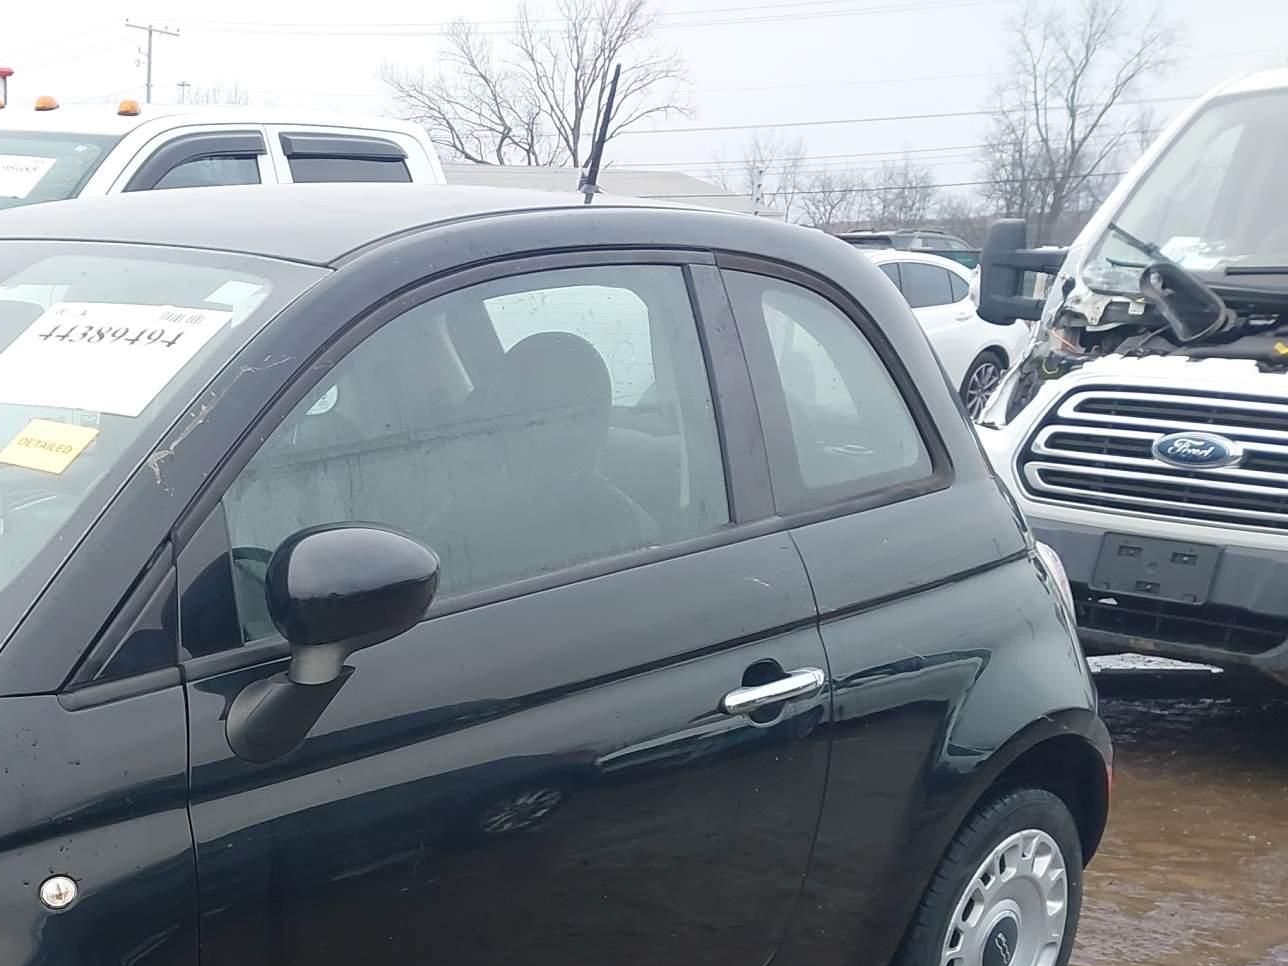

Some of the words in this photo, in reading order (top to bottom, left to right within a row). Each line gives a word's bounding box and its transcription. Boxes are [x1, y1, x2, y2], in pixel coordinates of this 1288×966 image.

[38, 324, 185, 348] 44389494
[16, 436, 72, 454] DETAILED
[1167, 438, 1215, 457] Ford
